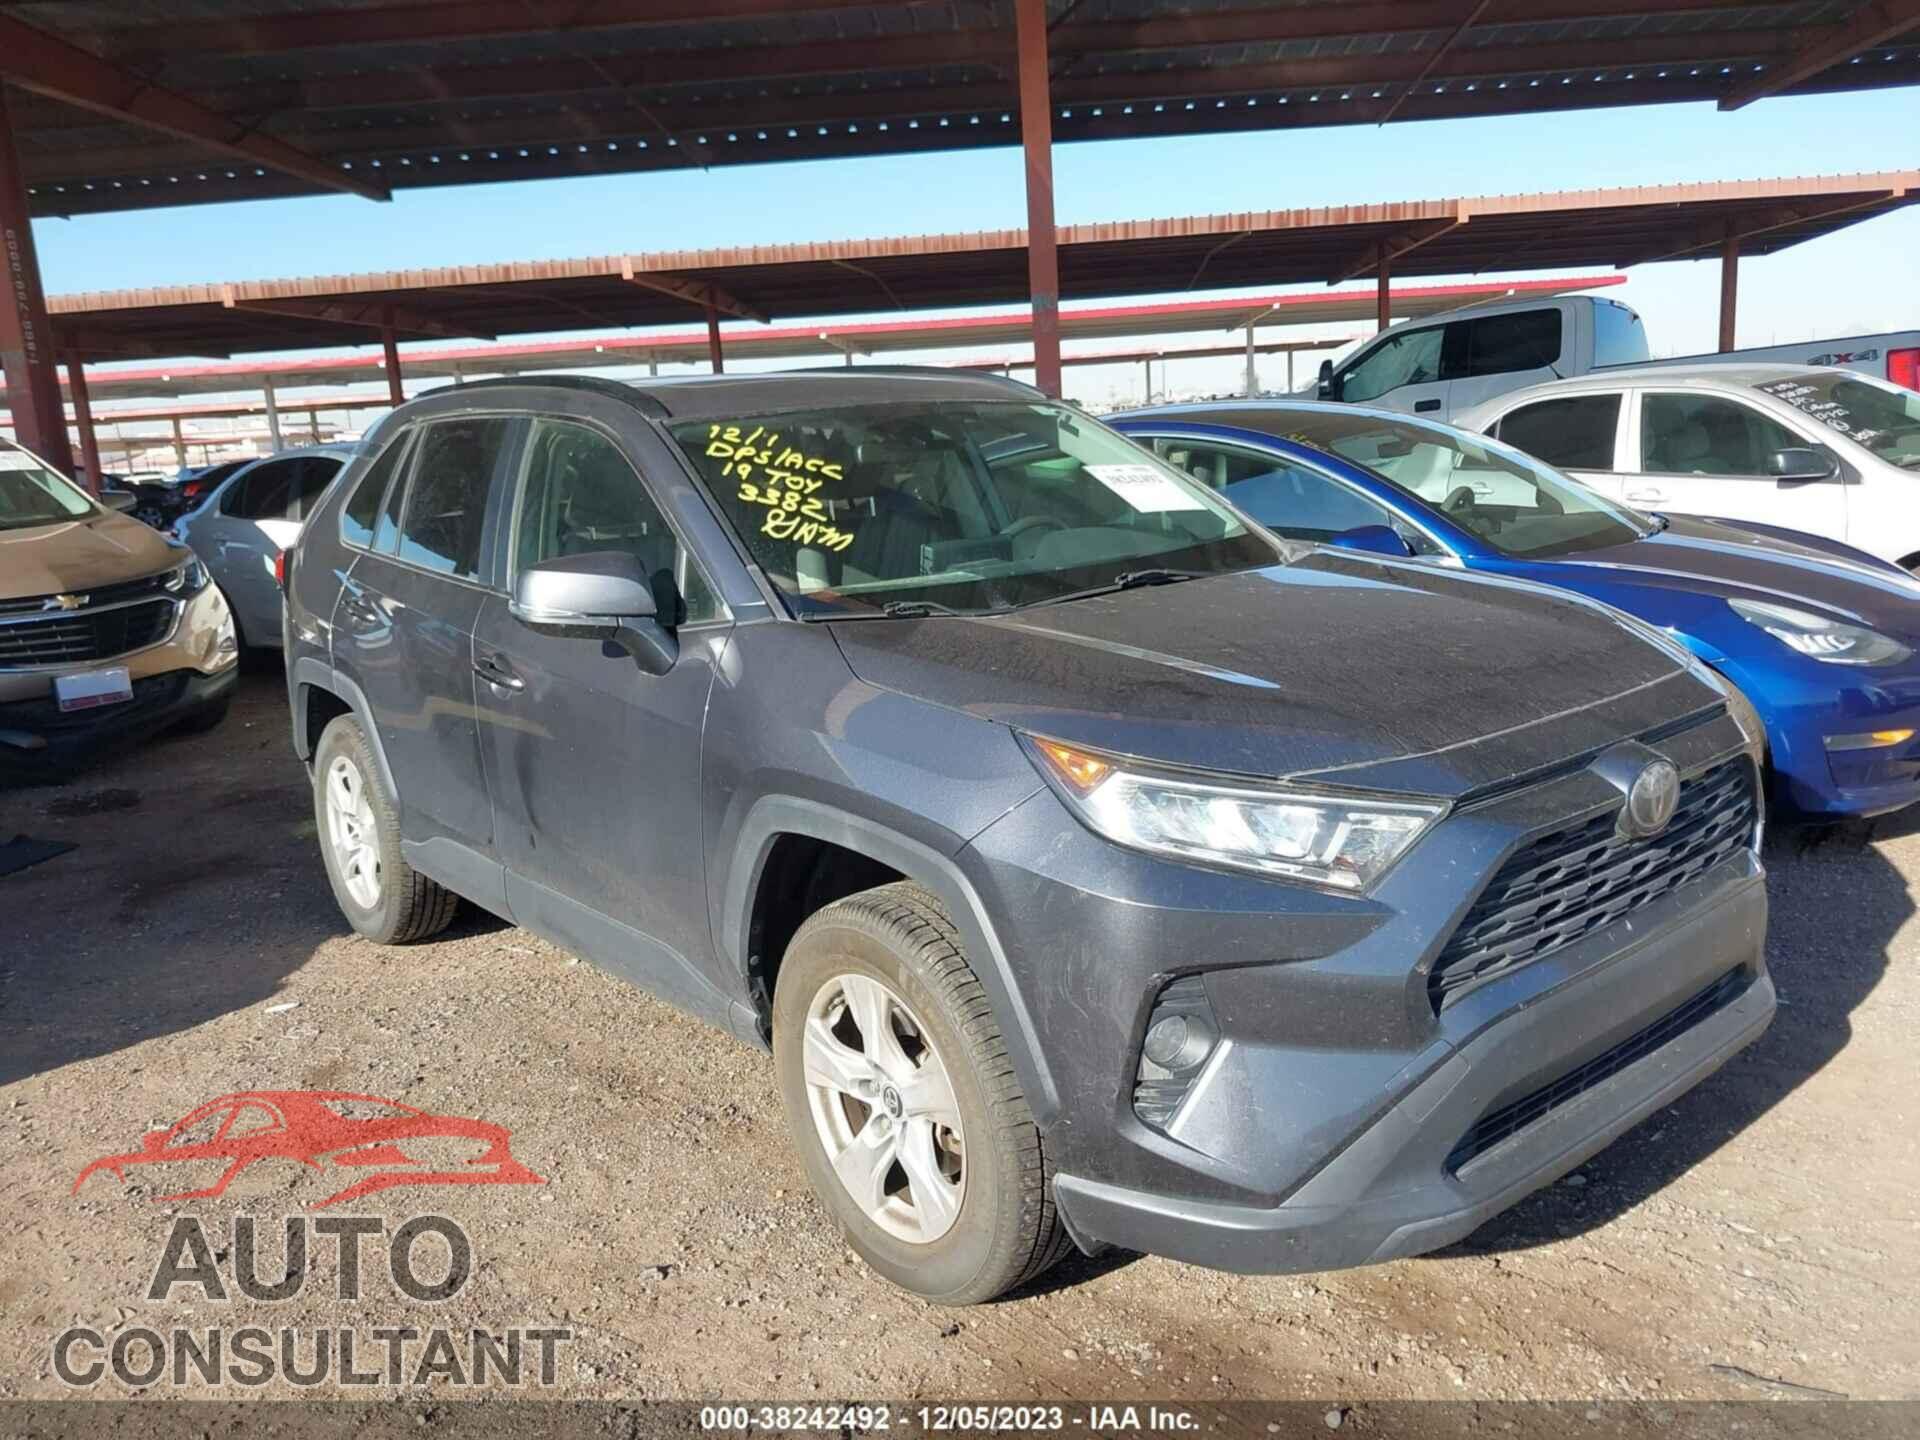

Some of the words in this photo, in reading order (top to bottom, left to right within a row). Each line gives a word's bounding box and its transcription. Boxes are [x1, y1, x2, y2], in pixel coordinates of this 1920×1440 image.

[1807, 348, 1879, 366] 4X4
[721, 461, 753, 481] 19
[764, 467, 823, 495] TOY
[737, 483, 828, 522] 3382
